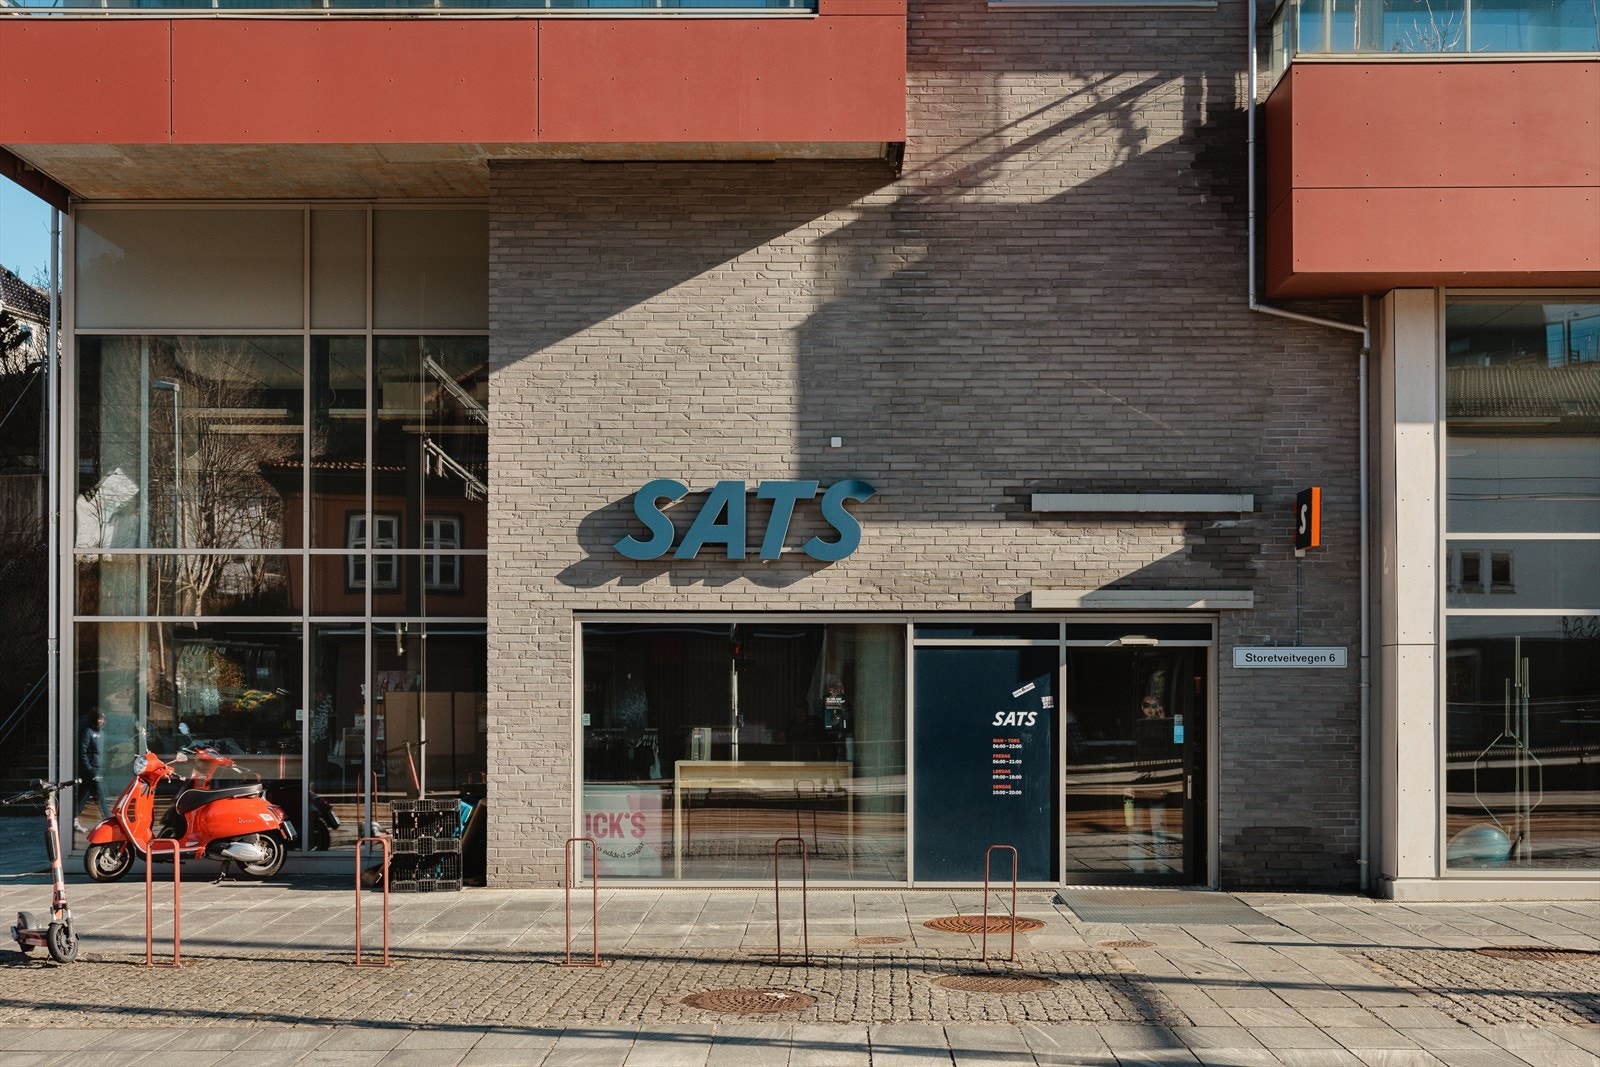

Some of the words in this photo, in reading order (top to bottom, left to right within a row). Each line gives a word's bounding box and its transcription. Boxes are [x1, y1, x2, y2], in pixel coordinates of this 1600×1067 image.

[613, 478, 877, 561] SATS
[1245, 653, 1326, 664] Storetveitvegen
[1329, 653, 1336, 662] 6
[992, 711, 1038, 726] SATS
[602, 850, 626, 859] added
[626, 841, 645, 858] sugar
